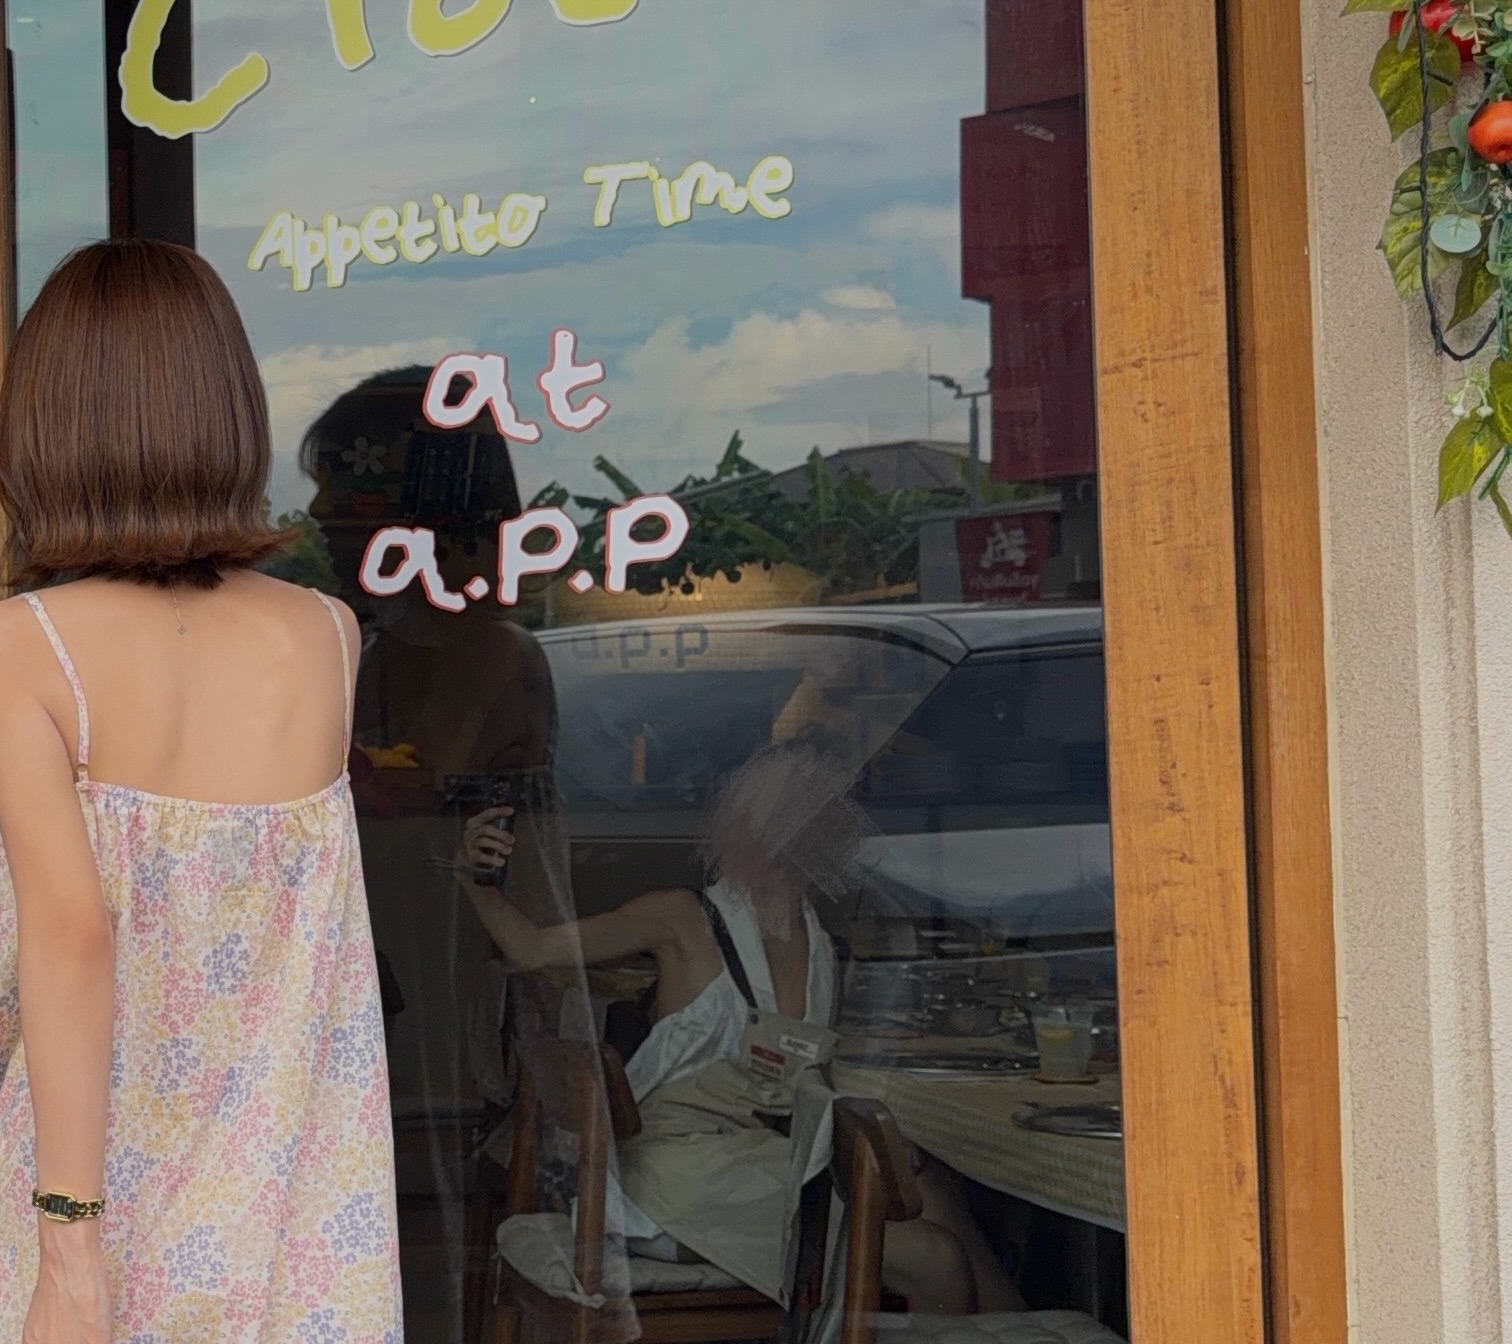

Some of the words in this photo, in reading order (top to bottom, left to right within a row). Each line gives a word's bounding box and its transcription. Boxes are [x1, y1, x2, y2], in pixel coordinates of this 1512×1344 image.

[248, 192, 547, 292] Appetito
[584, 156, 795, 228] Time
[423, 327, 610, 444] at
